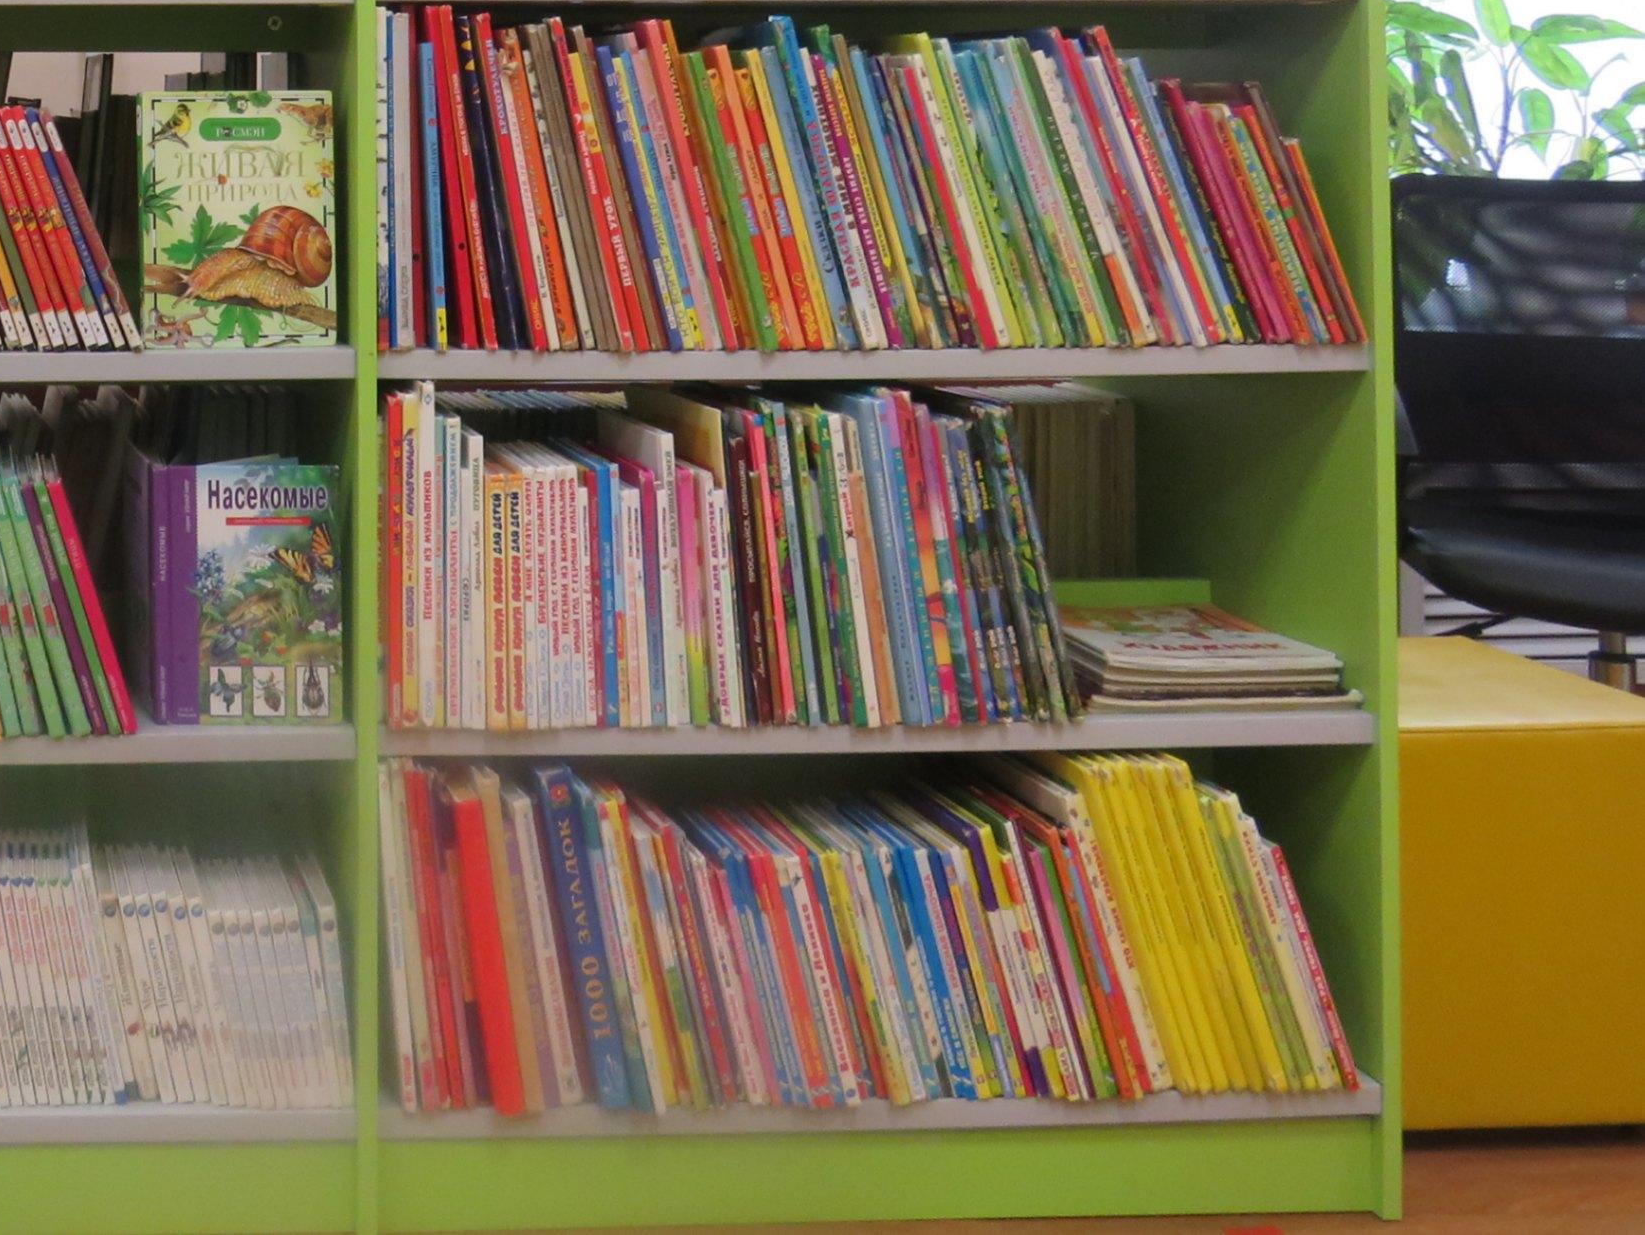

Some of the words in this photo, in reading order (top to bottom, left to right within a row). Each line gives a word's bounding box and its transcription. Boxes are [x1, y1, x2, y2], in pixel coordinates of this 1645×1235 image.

[175, 151, 305, 179] ЖИВАЯ
[187, 184, 299, 202] ПРИРОДА
[602, 196, 617, 230] УРОК
[611, 234, 632, 286] ПЕРВЫЙ
[208, 480, 326, 509] Насекомые
[537, 480, 545, 553] МУЗЫКАНТЫ
[423, 554, 432, 562] ИЗ
[424, 571, 432, 620] ПЕСЕНКИ
[538, 557, 547, 625] БРЕМЕНСКИЕ
[558, 819, 591, 945] ЗАГАДОК
[581, 956, 611, 1039] 1000
